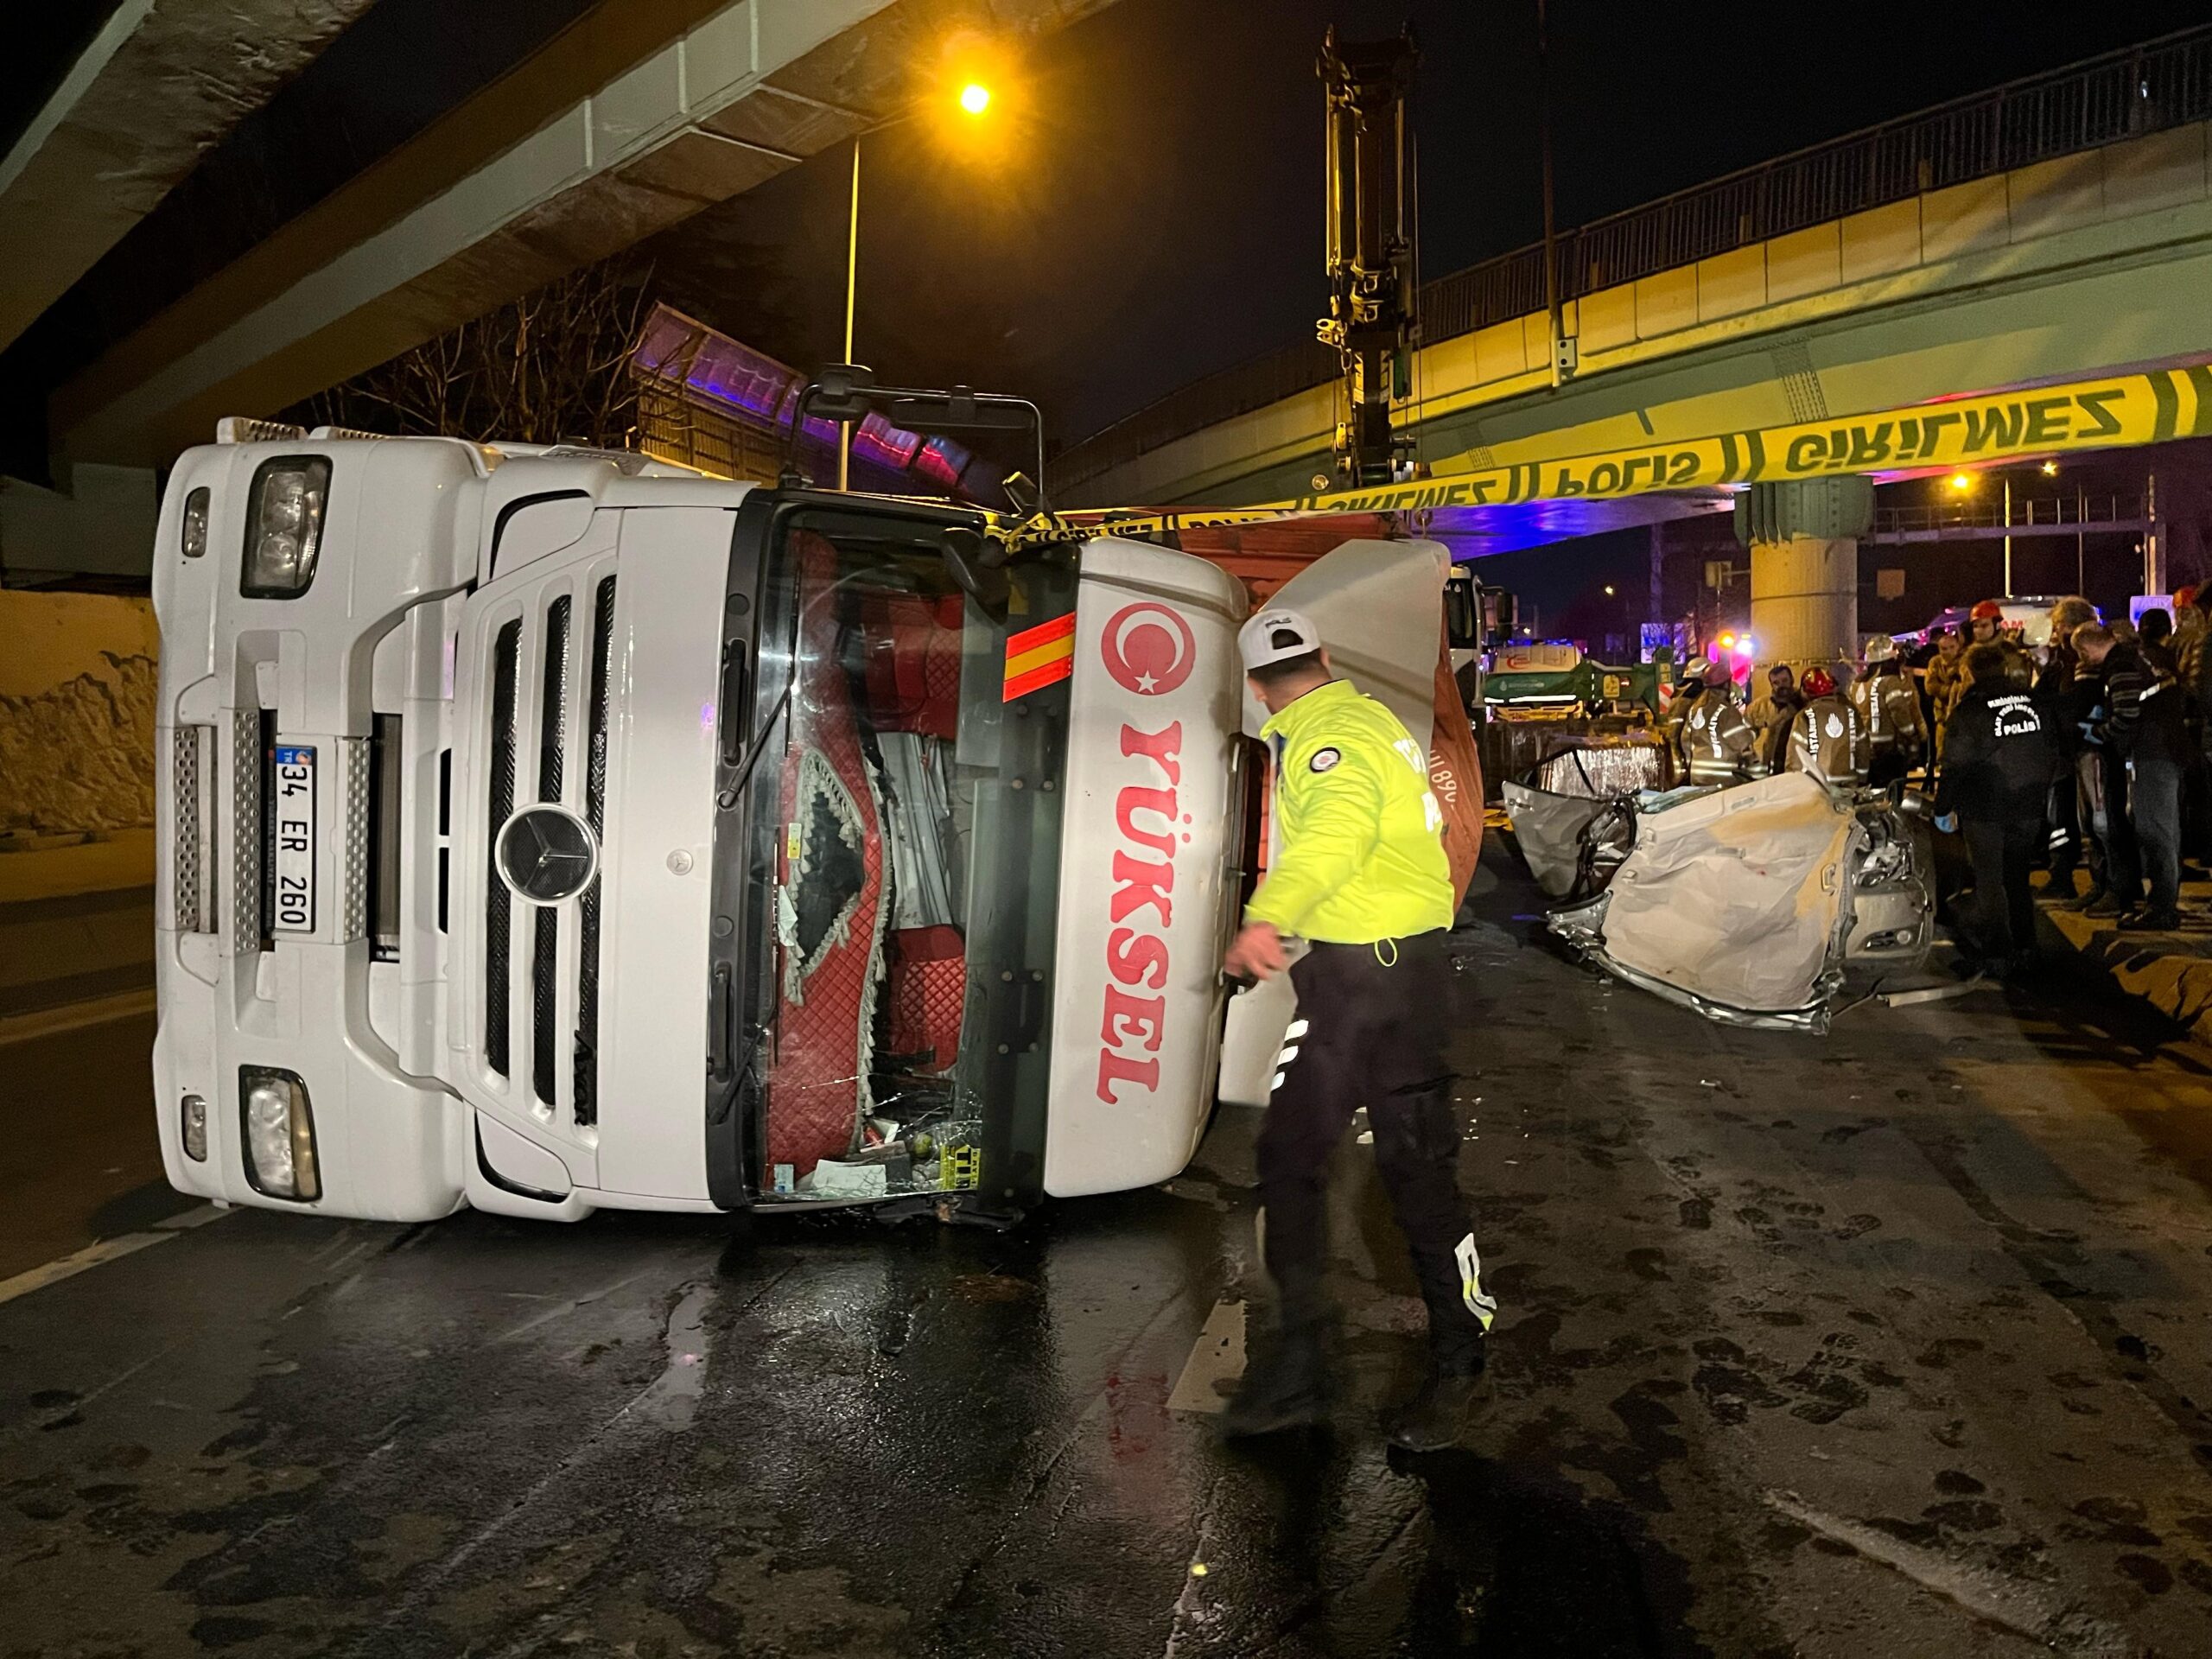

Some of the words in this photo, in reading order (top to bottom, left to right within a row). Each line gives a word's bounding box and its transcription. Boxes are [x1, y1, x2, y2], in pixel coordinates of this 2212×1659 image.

[283, 751, 292, 763] TR
[281, 766, 308, 797] 34
[281, 820, 308, 853] ER
[280, 876, 307, 925] 260
[1096, 721, 1192, 1104] YÜKSEL
